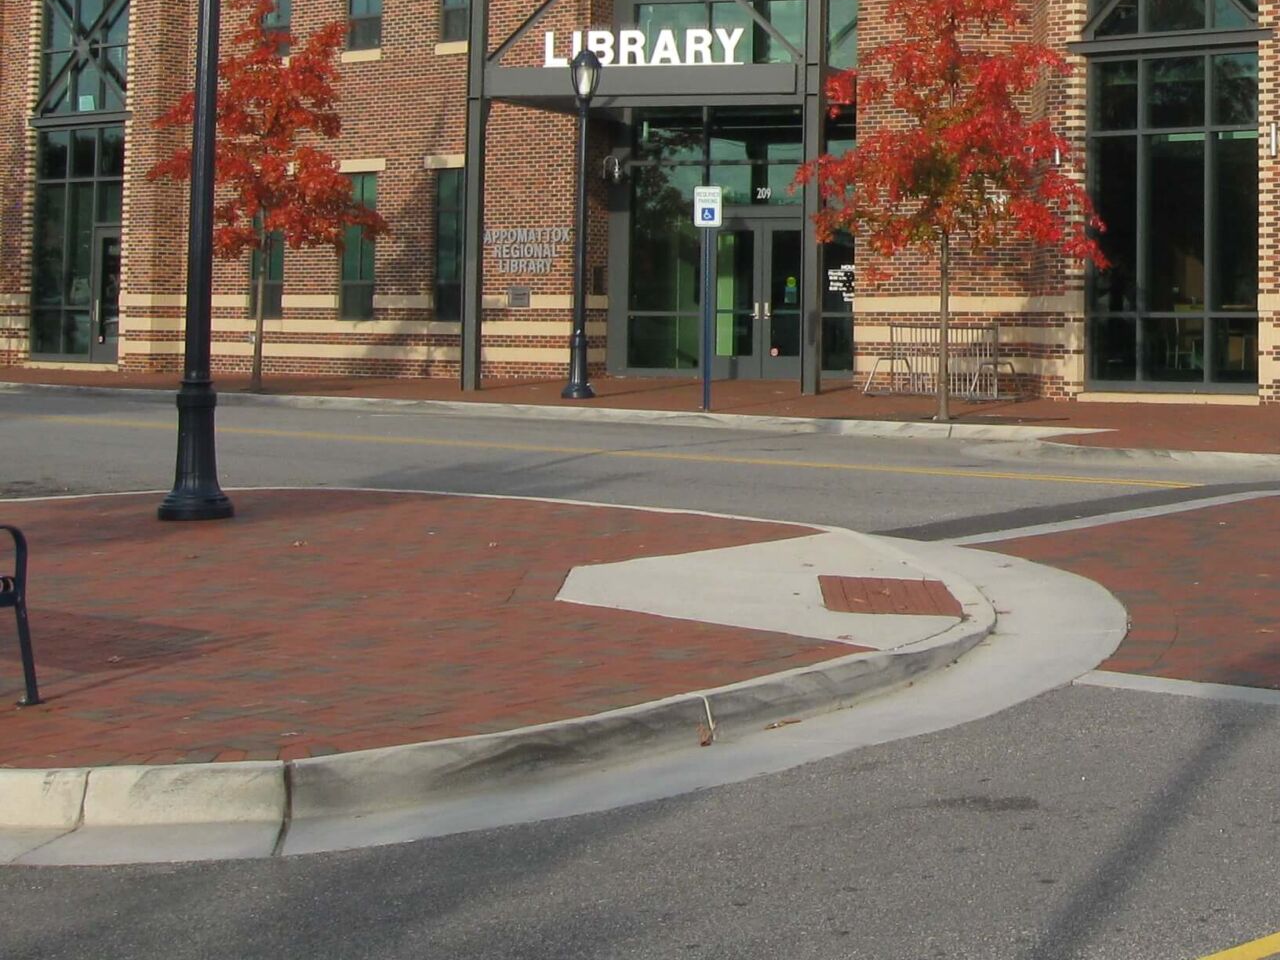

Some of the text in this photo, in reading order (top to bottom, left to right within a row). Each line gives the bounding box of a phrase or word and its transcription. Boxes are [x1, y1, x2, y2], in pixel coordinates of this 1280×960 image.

[543, 27, 745, 67] LIBRARY
[756, 187, 772, 199] 209
[483, 227, 571, 243] APPOMATTOX
[493, 243, 561, 259] REGIONAL
[499, 258, 554, 274] LIBRARY
